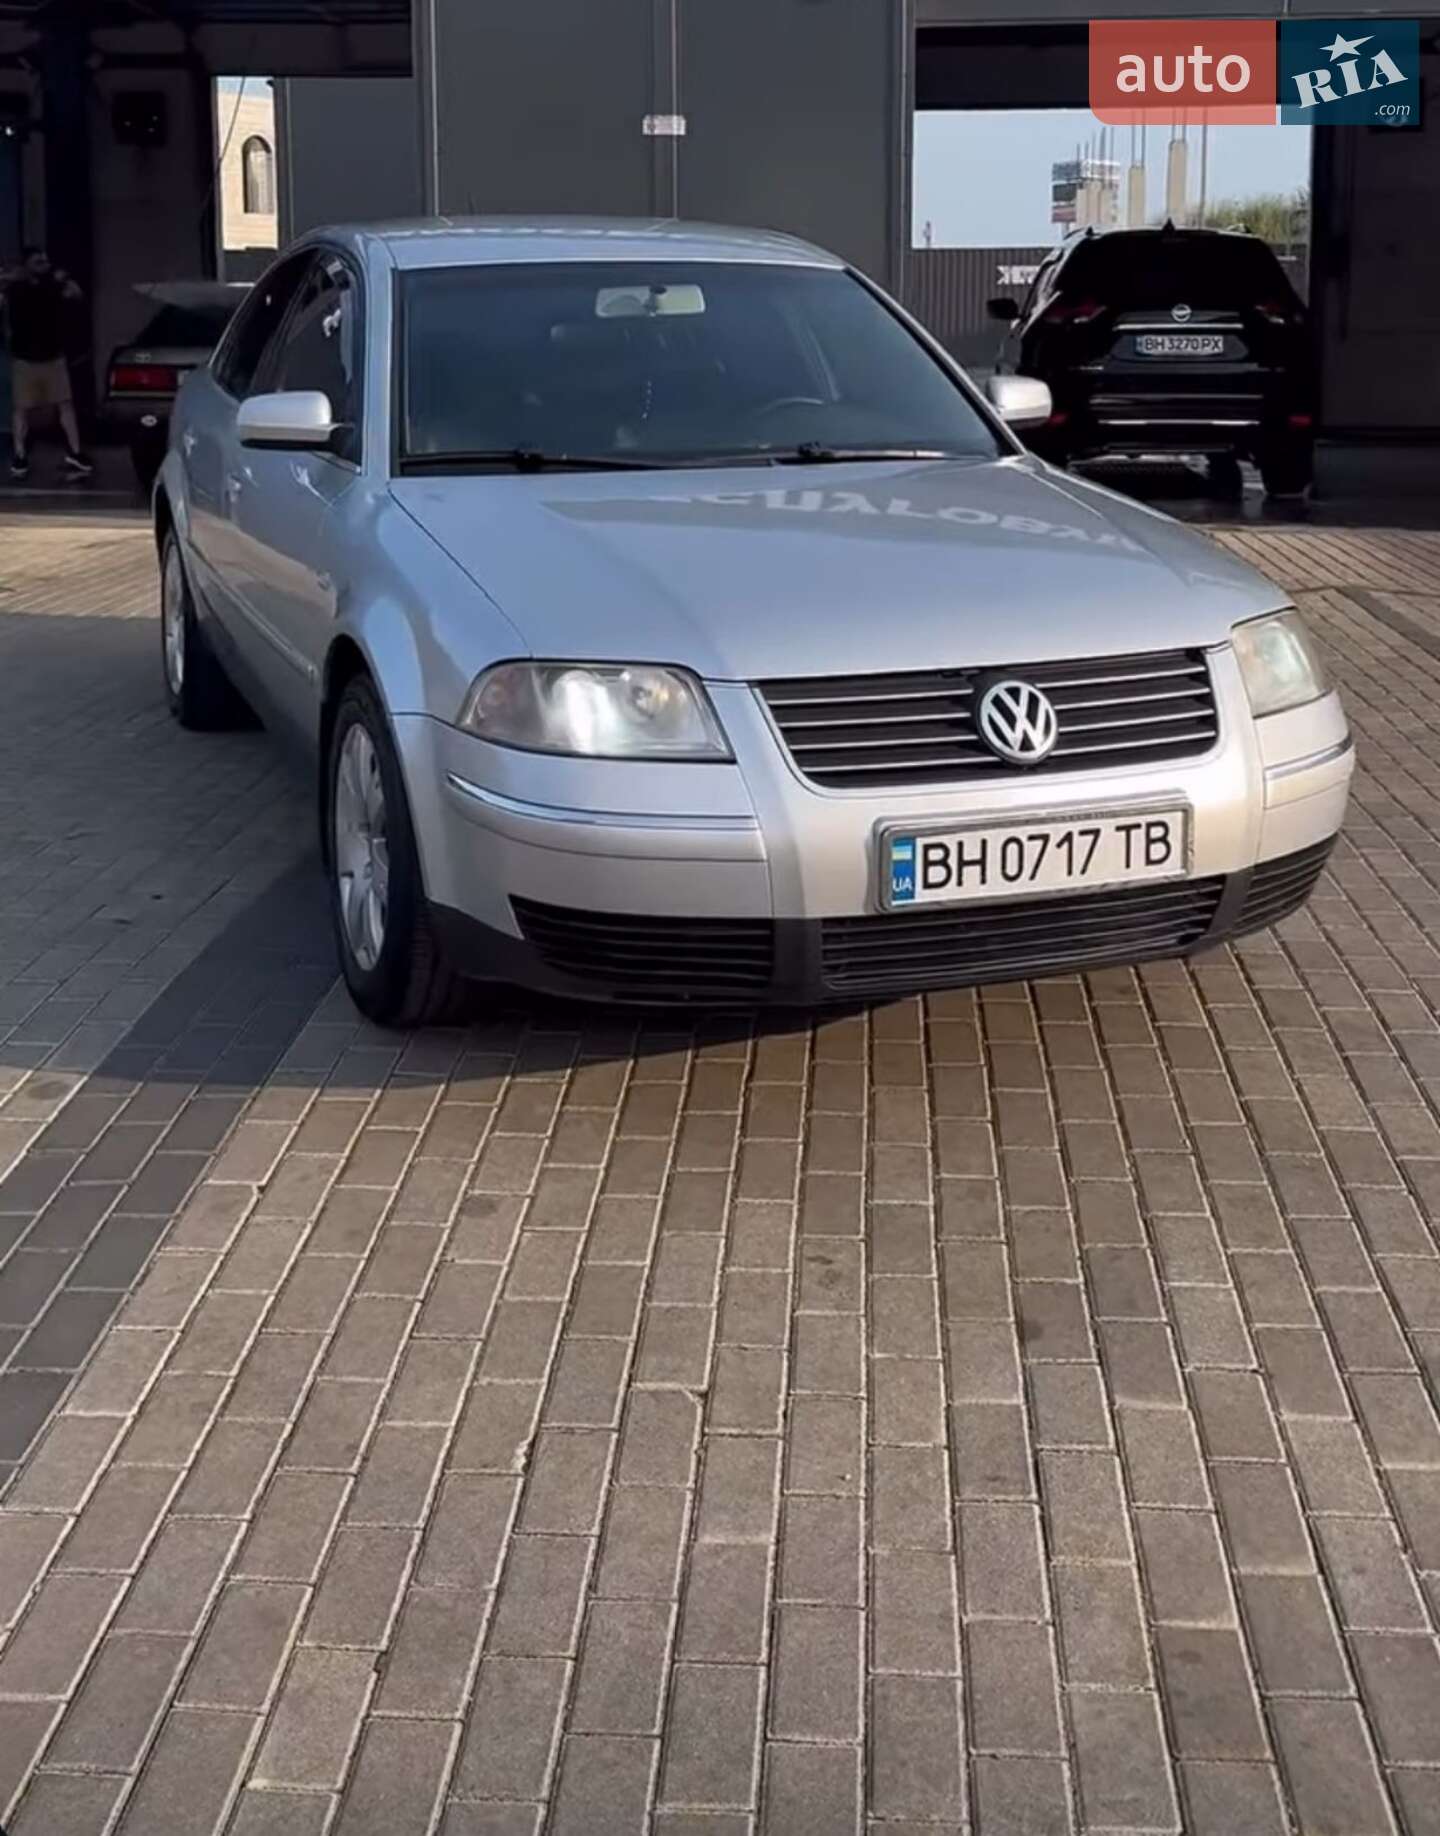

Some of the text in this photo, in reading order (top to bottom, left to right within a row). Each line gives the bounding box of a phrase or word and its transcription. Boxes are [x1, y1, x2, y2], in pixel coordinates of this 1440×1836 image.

[921, 820, 1172, 890] BH 0717 TB
[892, 877, 912, 892] UA
